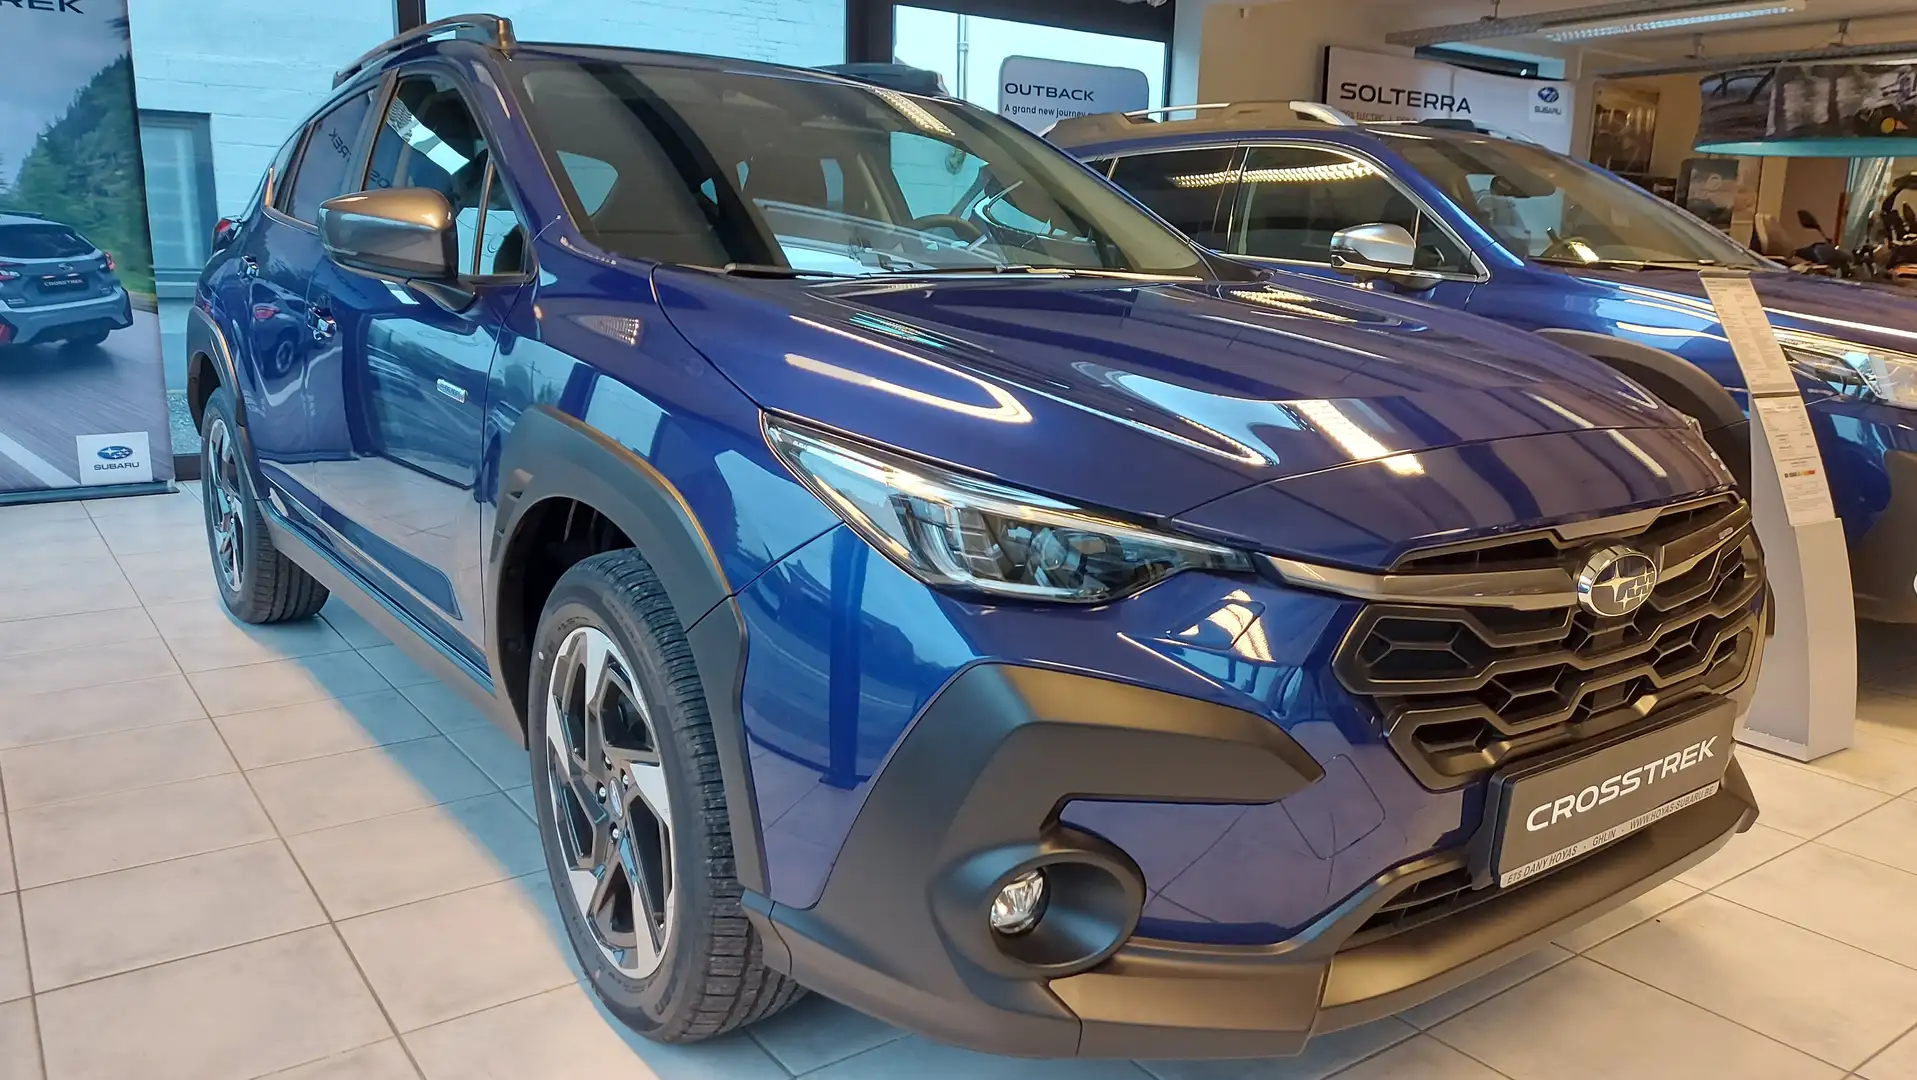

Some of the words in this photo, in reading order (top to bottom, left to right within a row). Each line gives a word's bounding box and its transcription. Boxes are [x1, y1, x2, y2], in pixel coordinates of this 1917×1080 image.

[1004, 82, 1095, 101] OUTBACK
[1339, 81, 1472, 114] SOLTERRA
[1004, 103, 1010, 112] A
[1012, 105, 1037, 115] grand
[1038, 108, 1055, 116] new
[93, 461, 140, 471] SUBARU
[1526, 735, 1718, 832] CROSSTREK
[1507, 870, 1523, 884] ETS
[1523, 858, 1549, 877] DANY
[1548, 845, 1578, 867] HOYAS
[1592, 828, 1617, 847] GHLIN
[1629, 785, 1715, 830] WWW.HOYAS-SUBARU.BE
